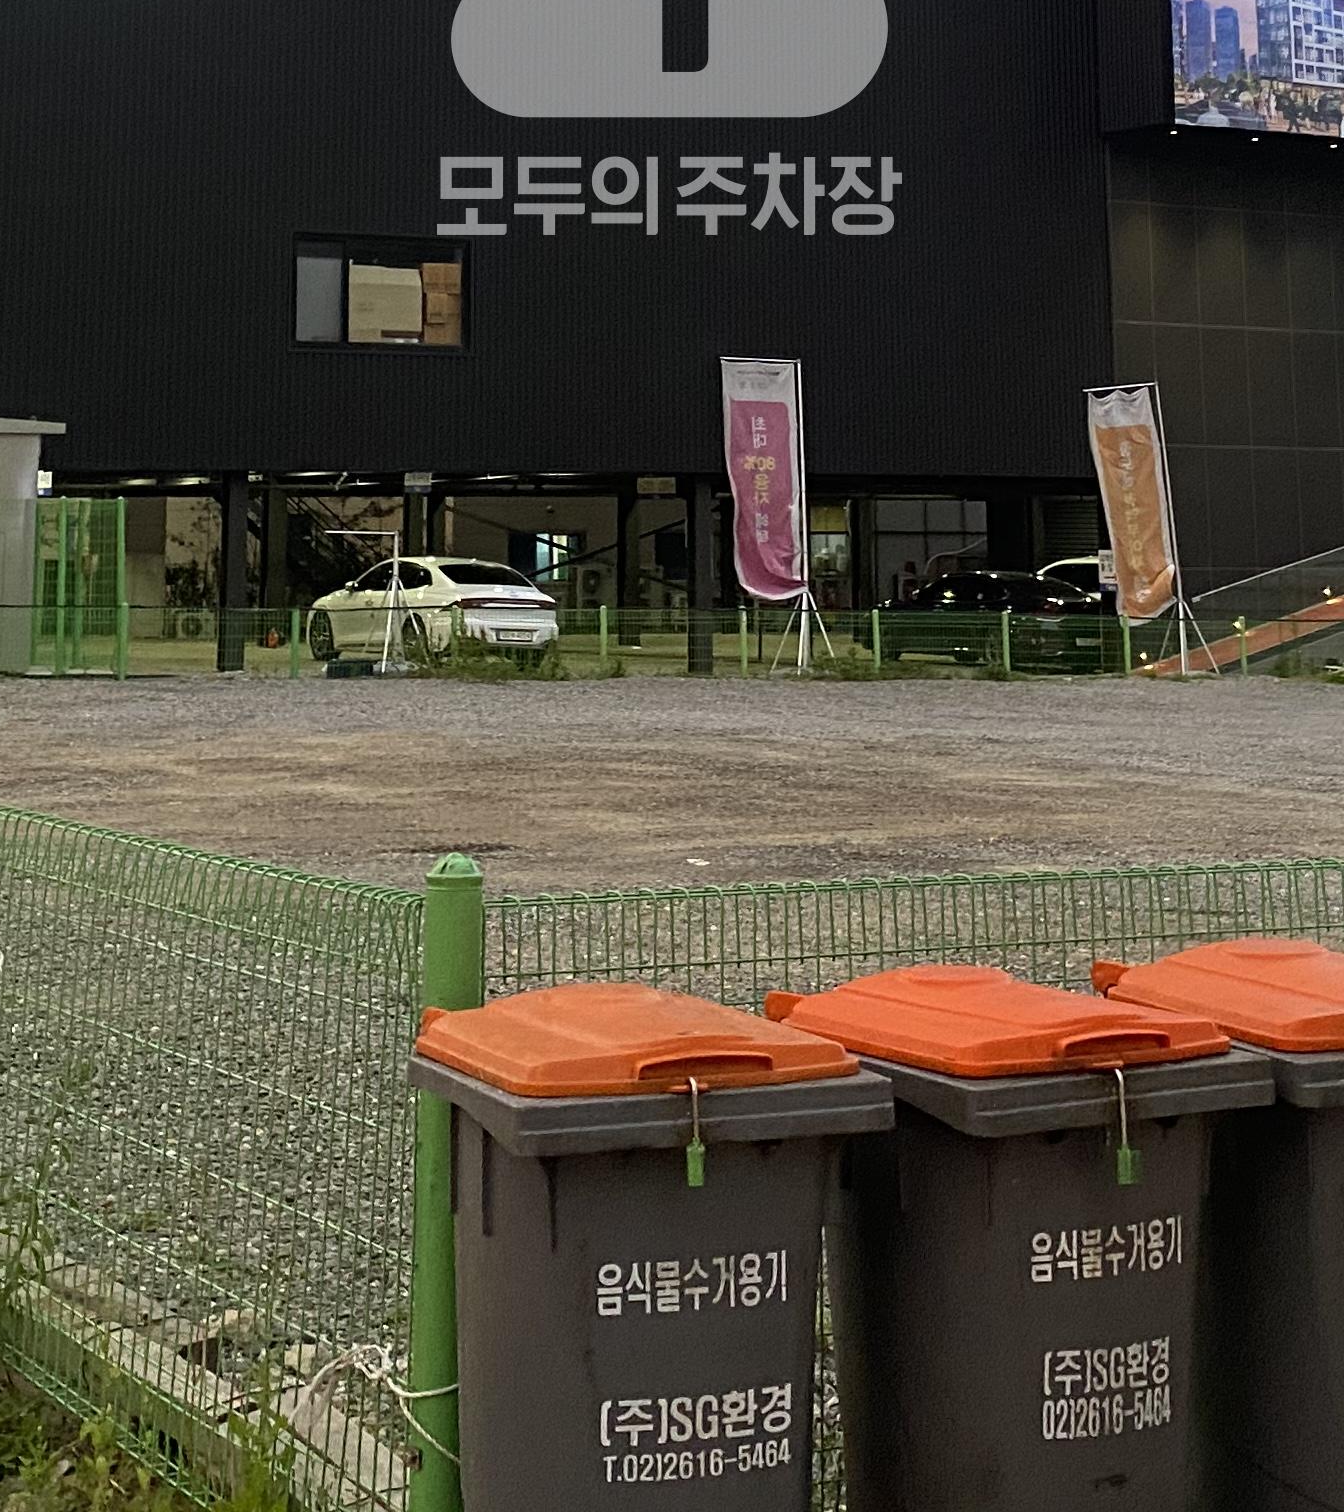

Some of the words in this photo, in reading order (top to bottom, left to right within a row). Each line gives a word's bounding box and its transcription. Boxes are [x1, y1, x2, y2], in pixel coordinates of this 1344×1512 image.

[1031, 1215, 1182, 1282] 음식물수거용기
[596, 1249, 787, 1316] 음식물수거용기
[1042, 1384, 1171, 1440] 02)2616-5464
[603, 1438, 792, 1483] T.02)2616-5464
